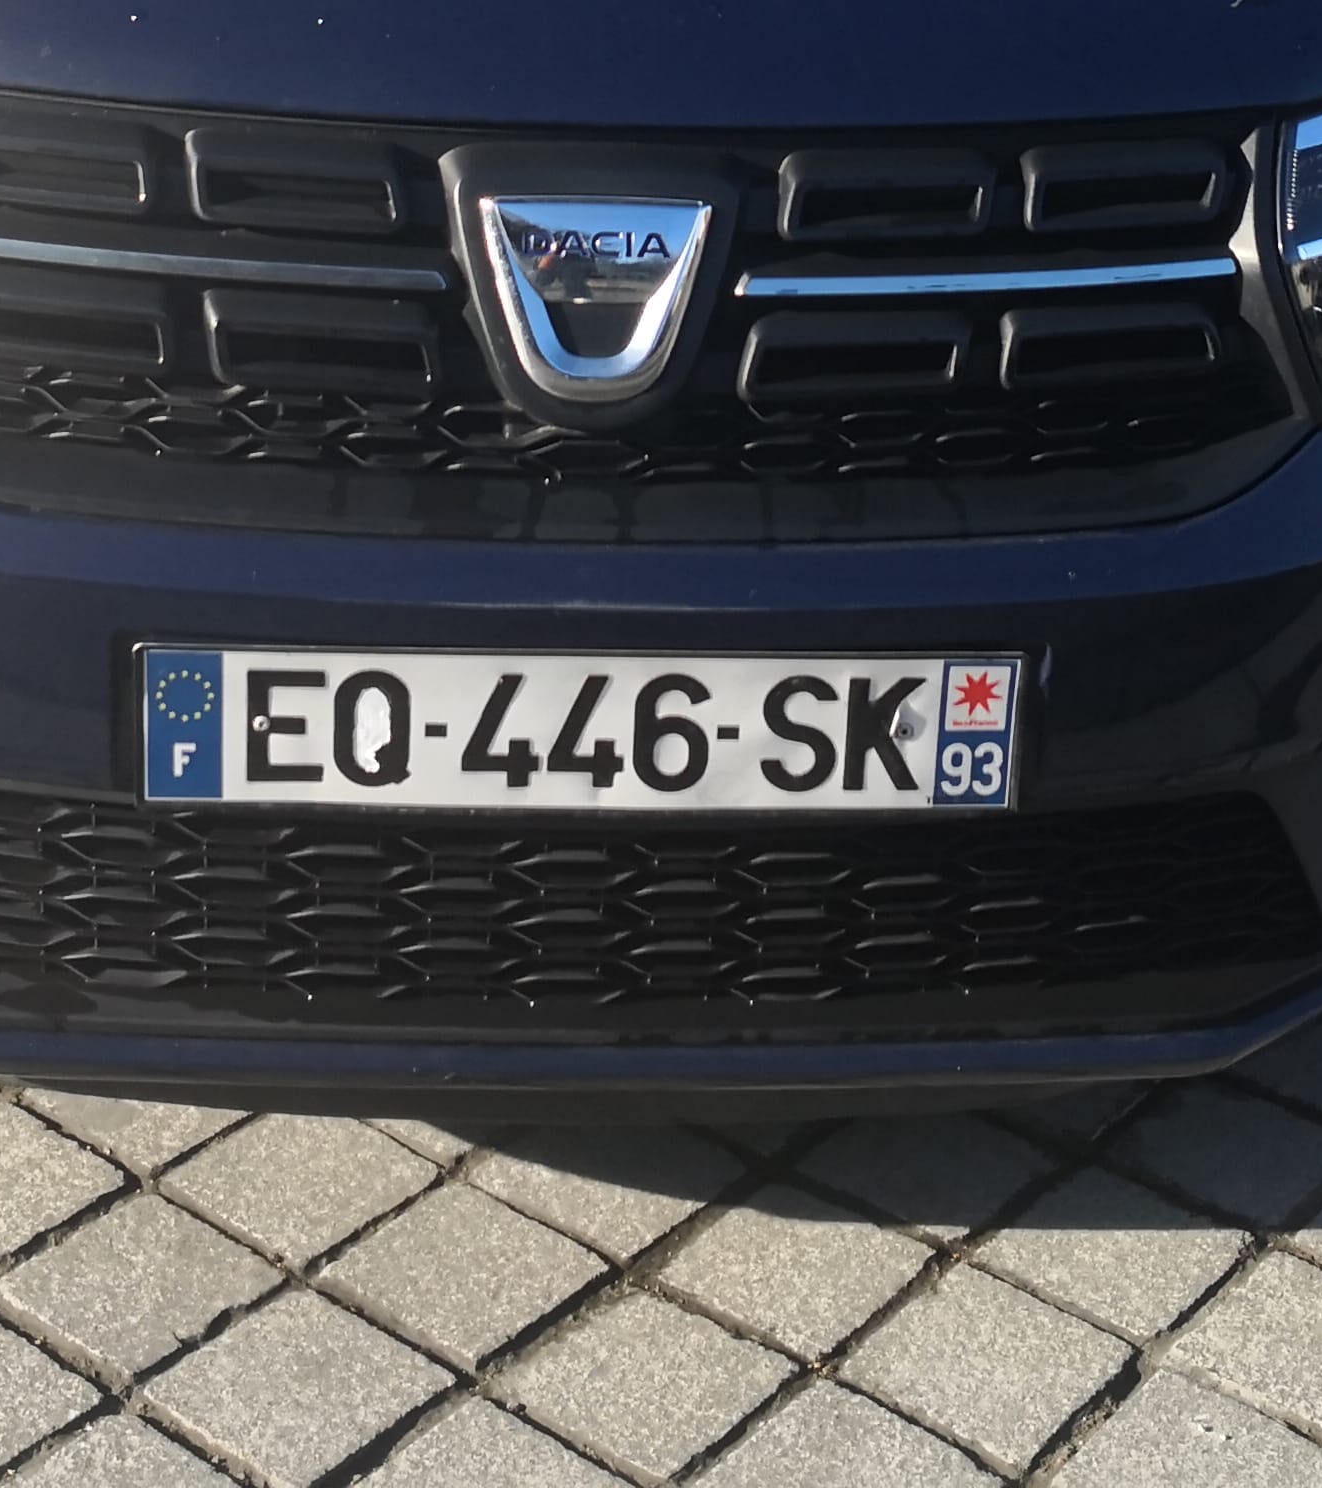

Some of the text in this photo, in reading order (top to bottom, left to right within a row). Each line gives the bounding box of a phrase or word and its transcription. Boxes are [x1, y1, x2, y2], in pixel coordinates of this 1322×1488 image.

[523, 230, 671, 258] DACIA
[246, 669, 926, 792] EQ-446-SK
[173, 742, 197, 778] F
[940, 741, 1004, 796] 93
